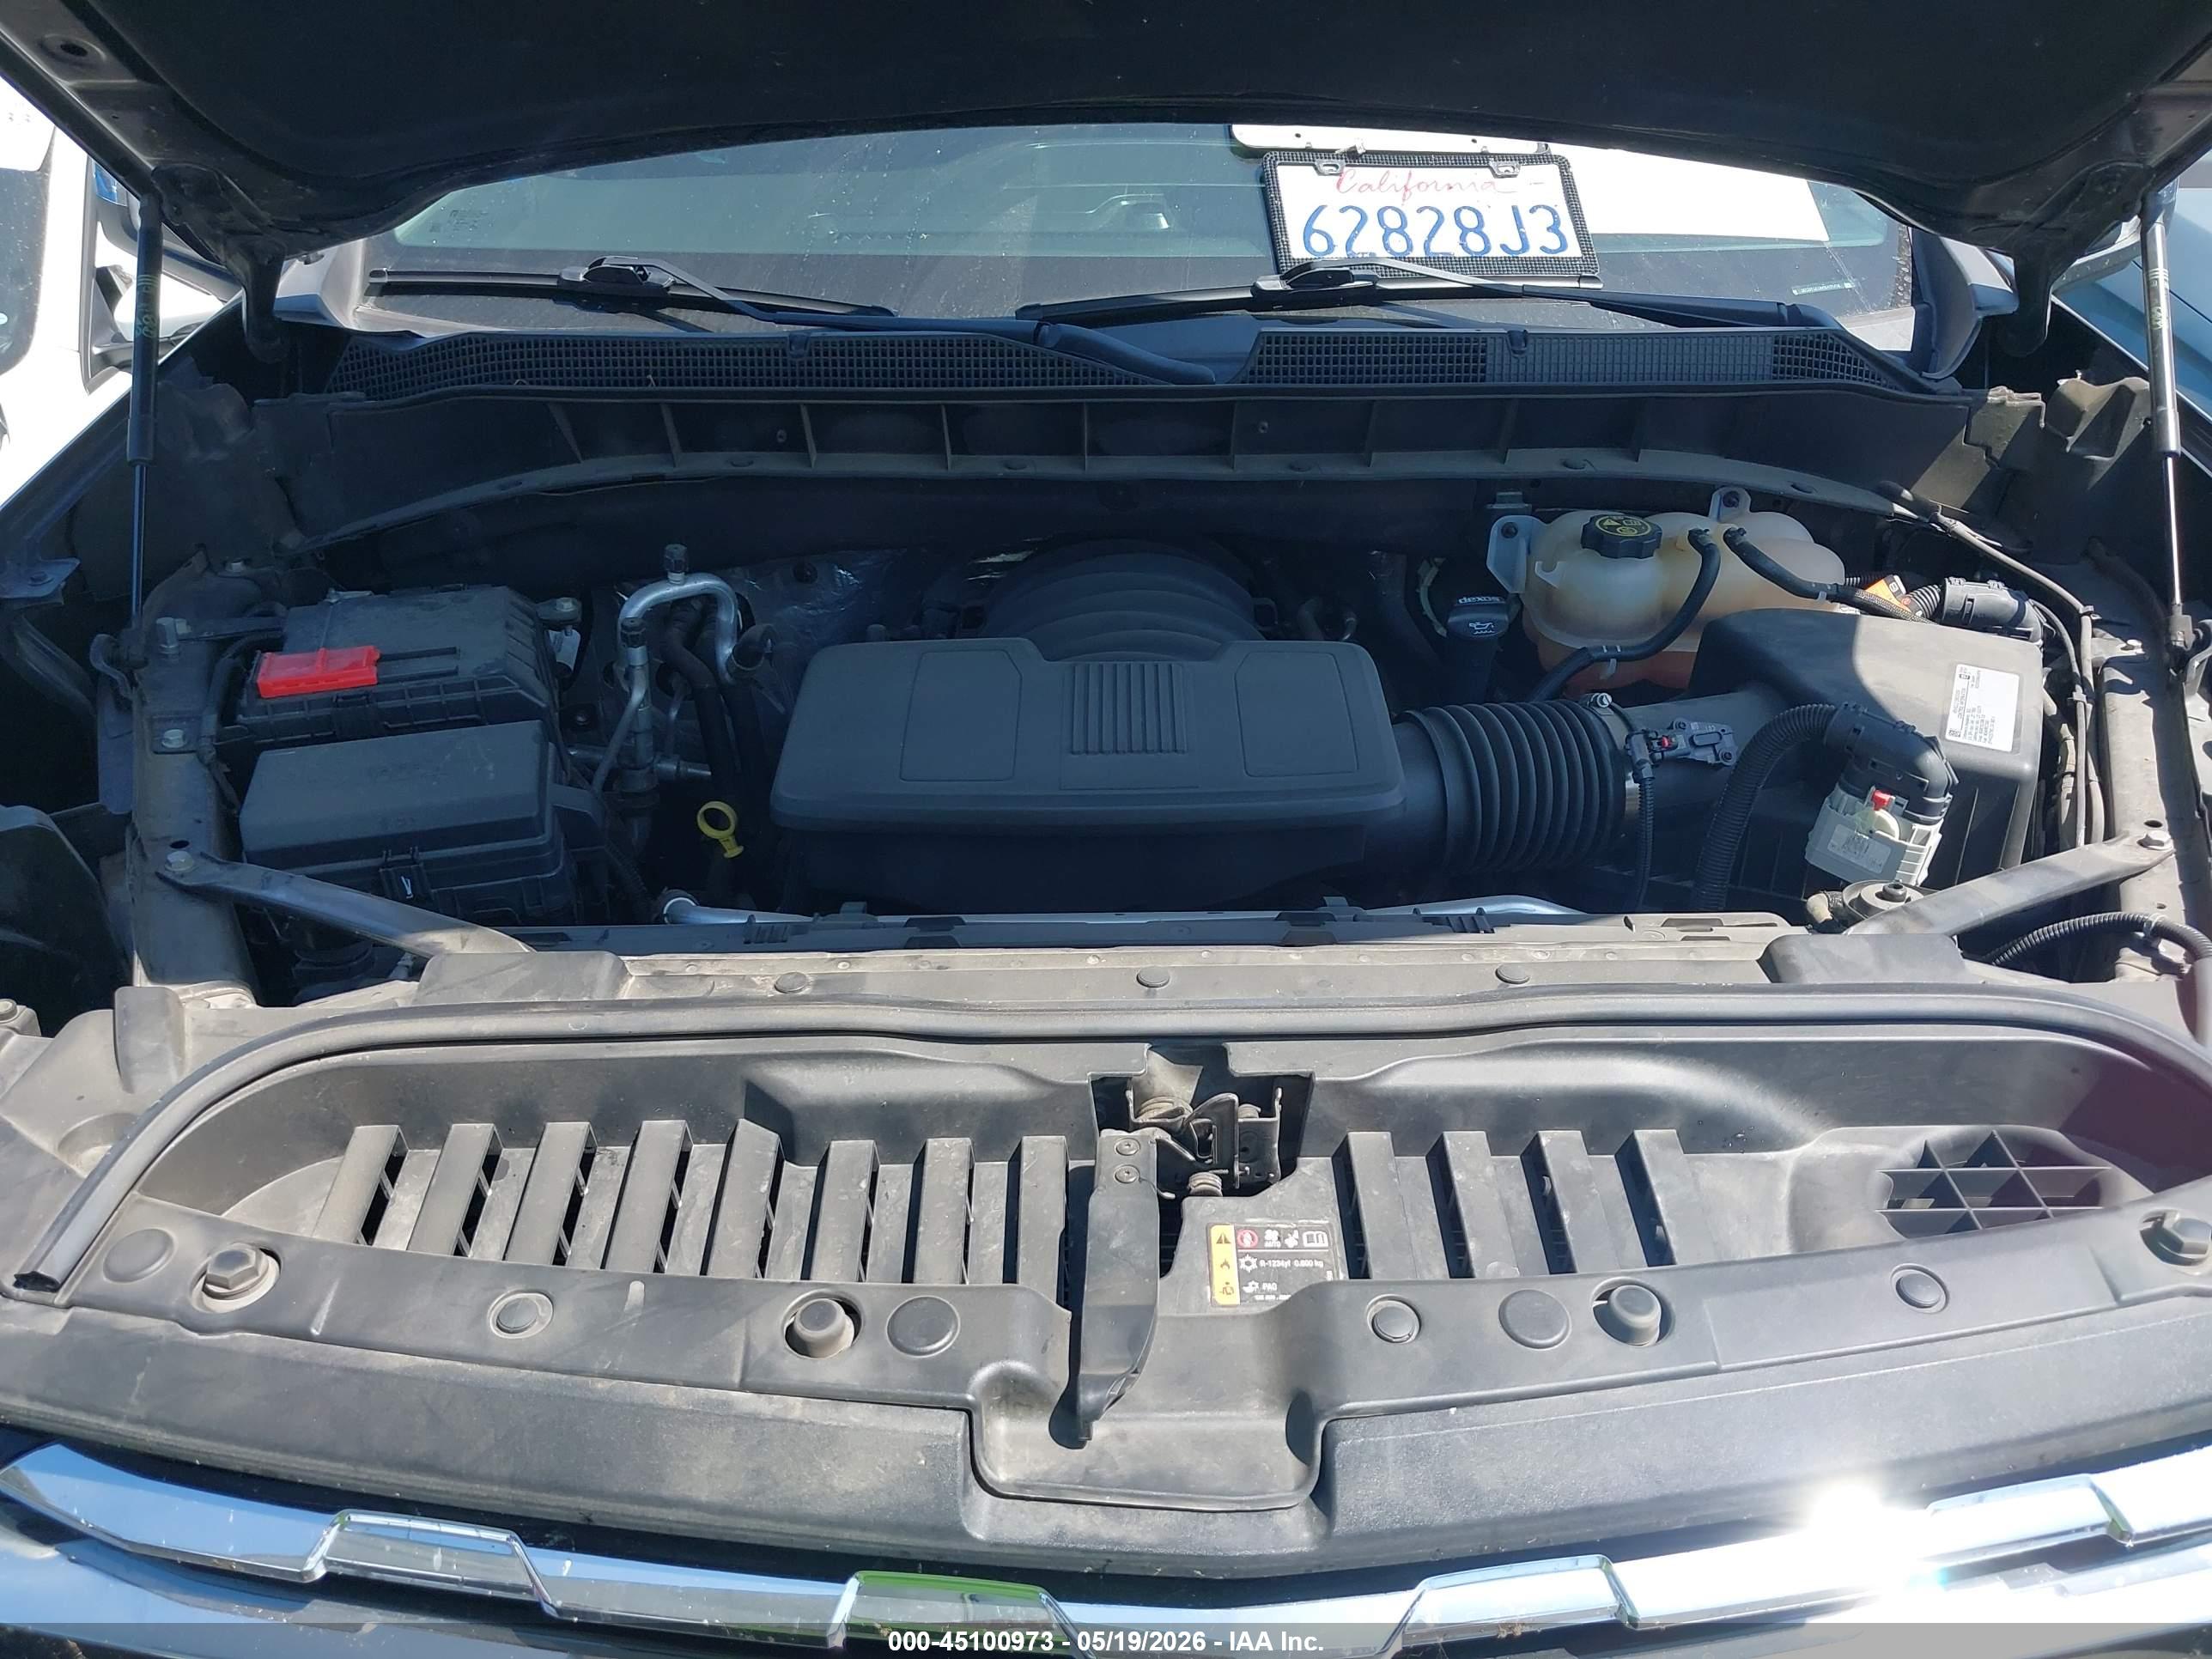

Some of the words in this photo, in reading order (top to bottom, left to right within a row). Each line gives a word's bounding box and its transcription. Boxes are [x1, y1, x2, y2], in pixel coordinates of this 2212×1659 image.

[1335, 168, 1517, 203] California
[1303, 204, 1570, 258] 62828J3
[1259, 1259, 1291, 1268] R-1234yf
[1314, 1258, 1324, 1268] kg
